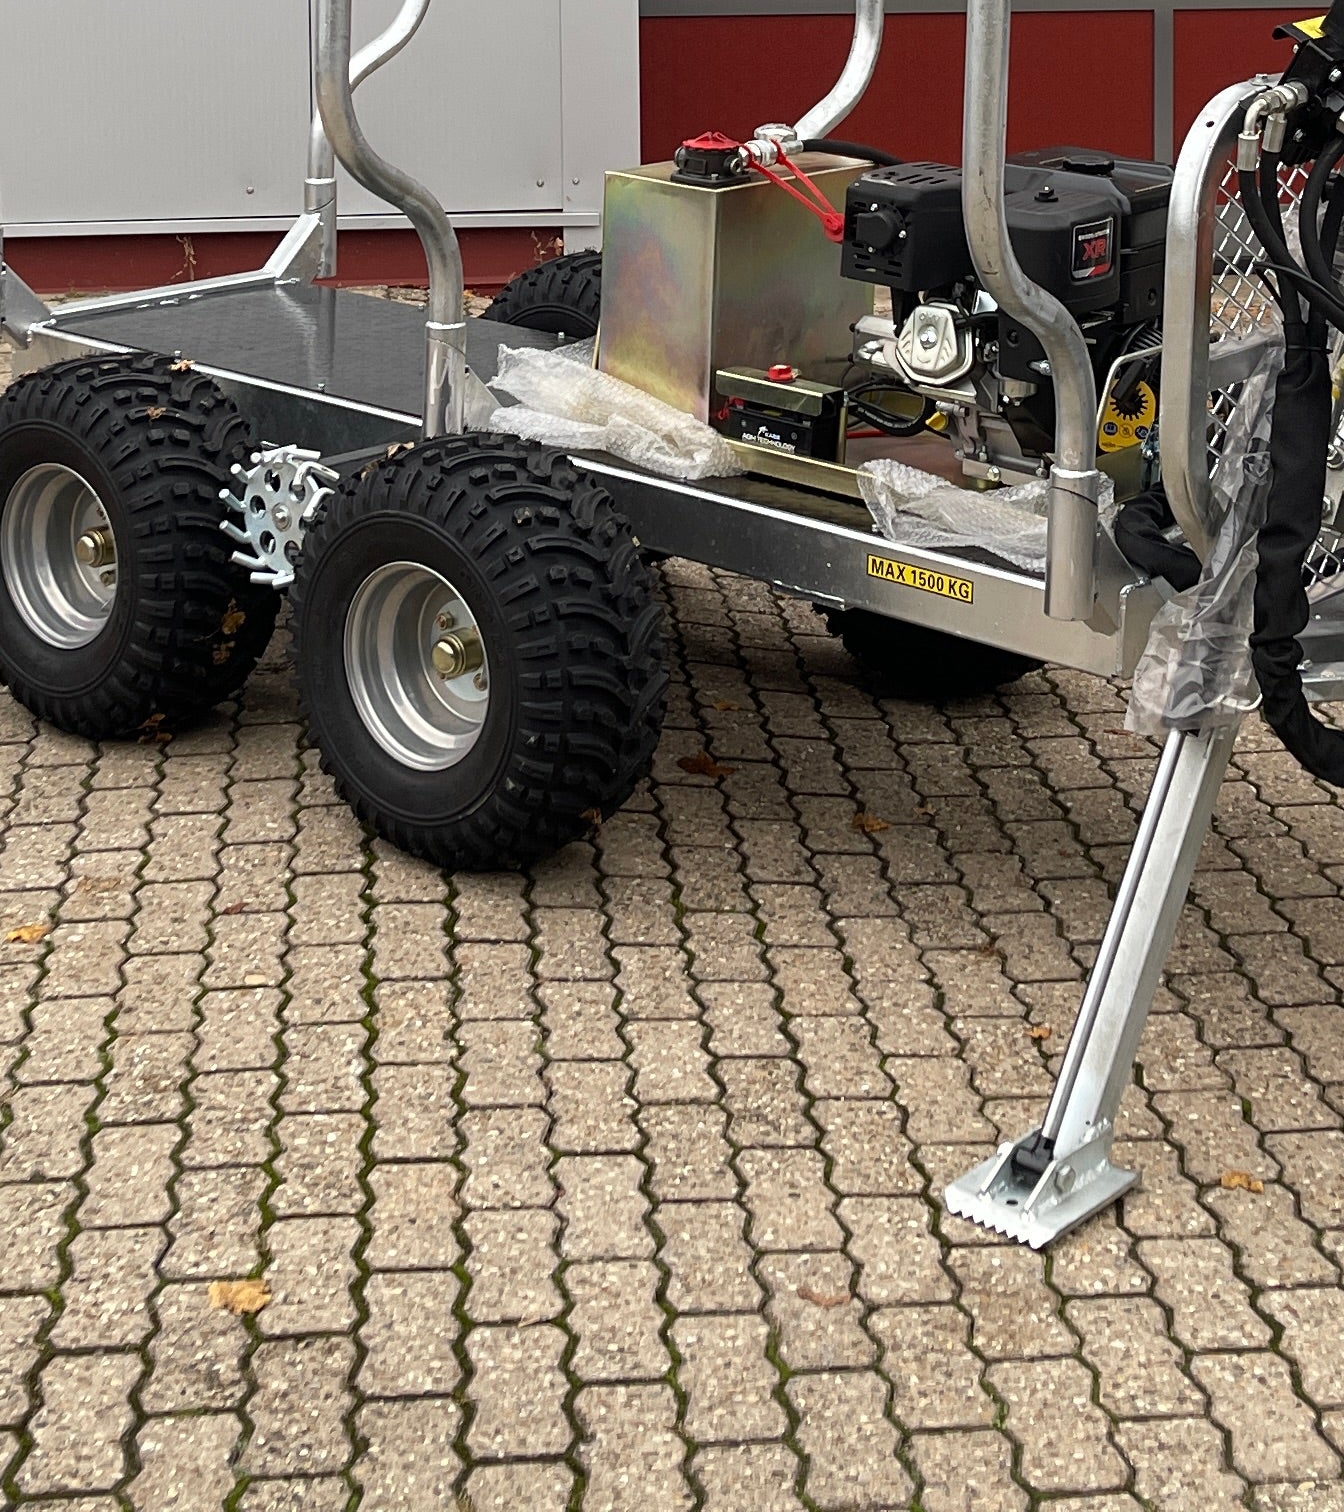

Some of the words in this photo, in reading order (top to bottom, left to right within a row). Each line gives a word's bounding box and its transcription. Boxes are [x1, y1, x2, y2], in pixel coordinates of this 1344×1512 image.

[871, 558, 906, 582] MAX
[910, 569, 944, 592] 1500
[948, 579, 970, 599] KG
